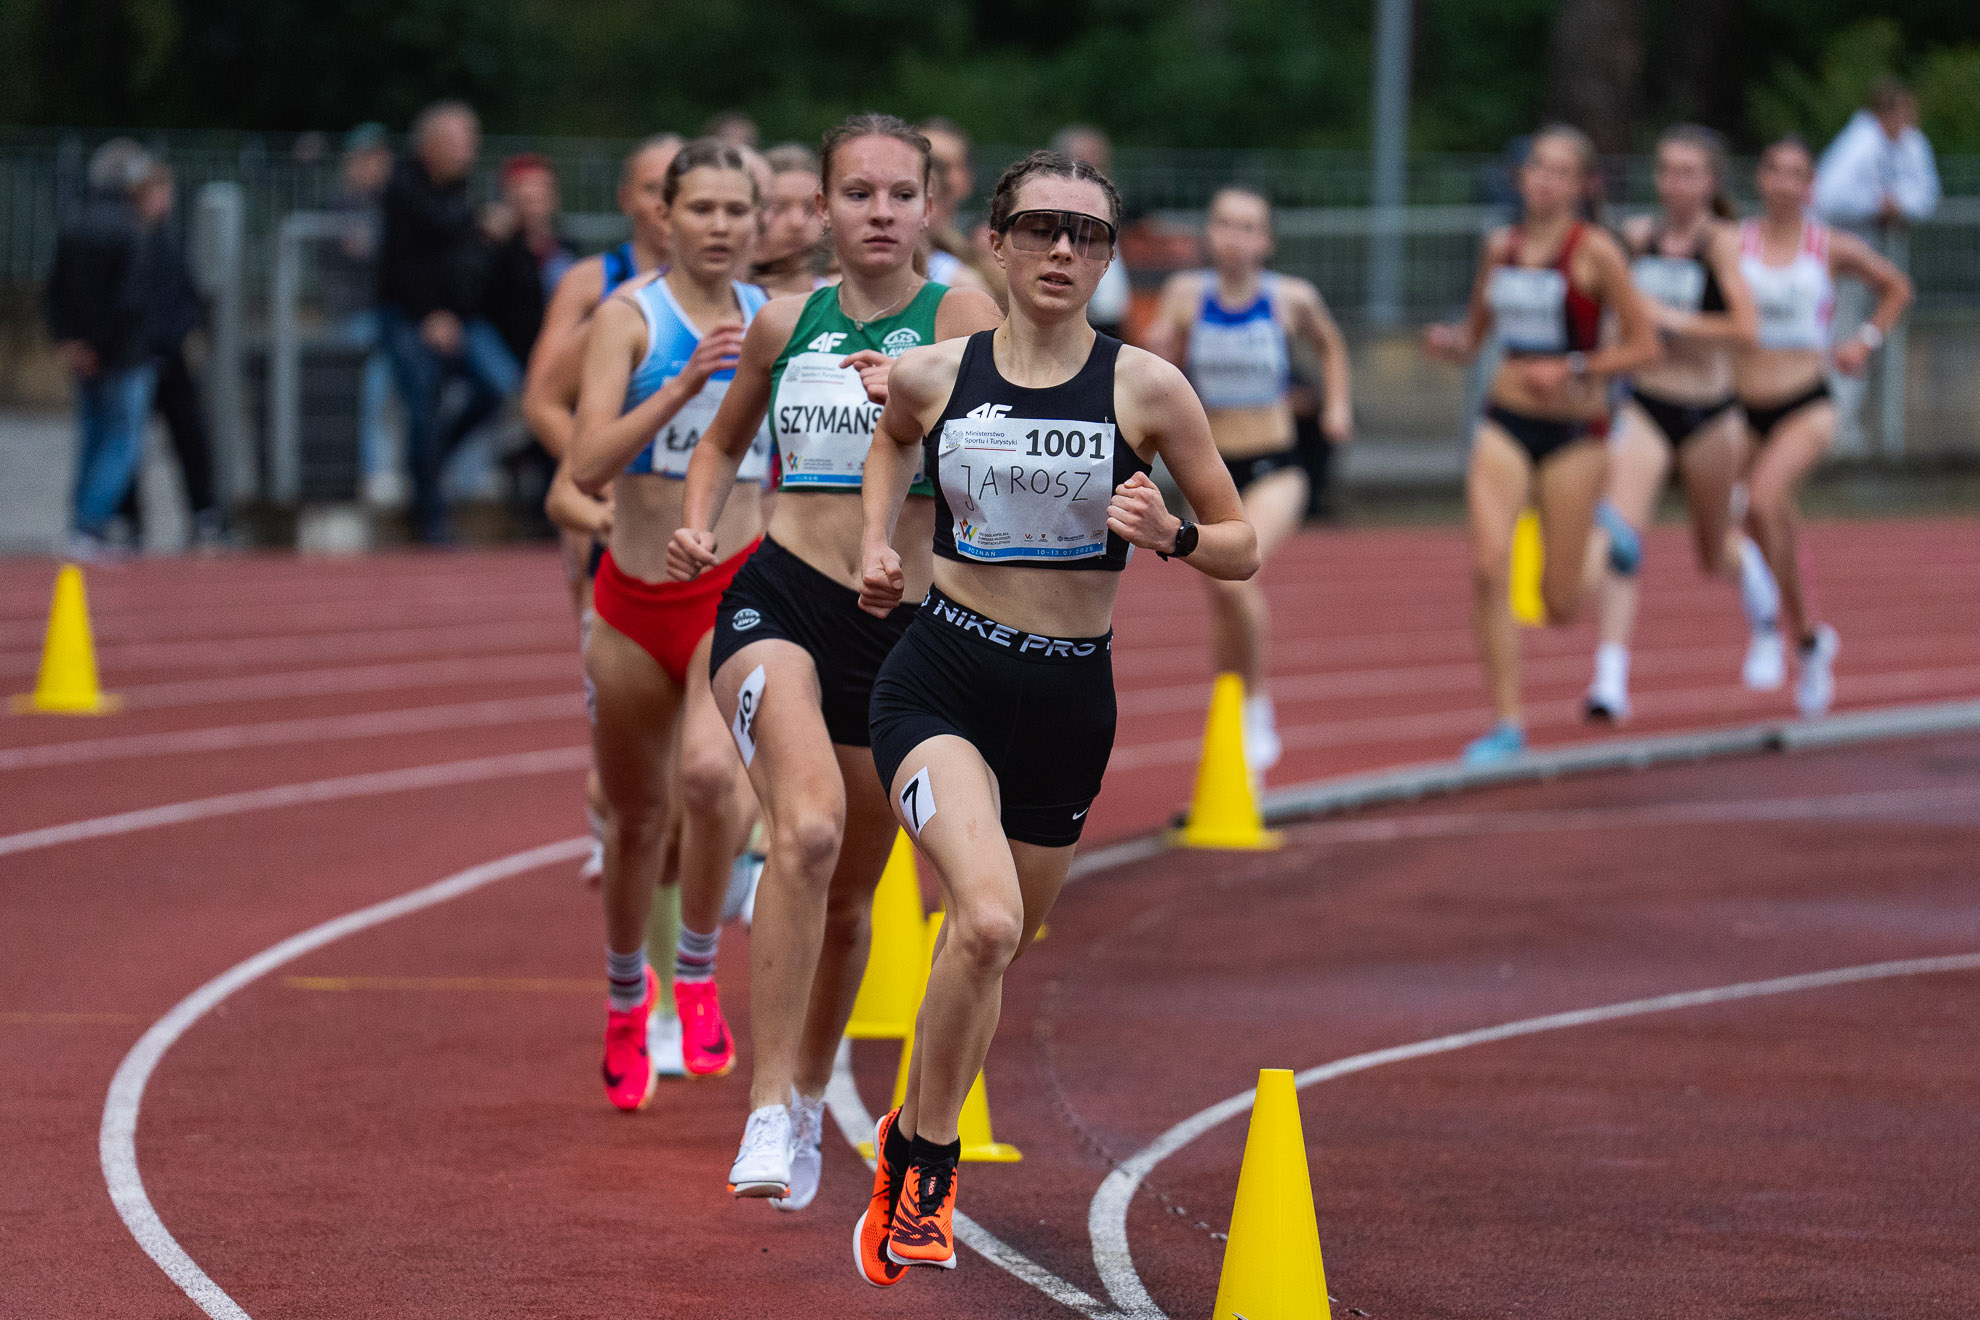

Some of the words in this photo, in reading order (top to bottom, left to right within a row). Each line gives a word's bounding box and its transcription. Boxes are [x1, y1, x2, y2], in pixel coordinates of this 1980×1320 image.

[807, 331, 848, 353] 4F
[780, 400, 883, 435] SZYMAŃS
[964, 437, 985, 445] Sportu
[990, 438, 1018, 447] Turystyki
[965, 430, 1005, 438] Ministerstwo
[1025, 429, 1105, 459] 1001
[961, 464, 1091, 511] JAROSZ
[968, 546, 996, 557] POZNAŃ
[1036, 546, 1094, 556] 10-13.07.2025
[933, 599, 1019, 648] NIKE
[1019, 634, 1097, 657] PRO
[902, 777, 919, 831] 7
